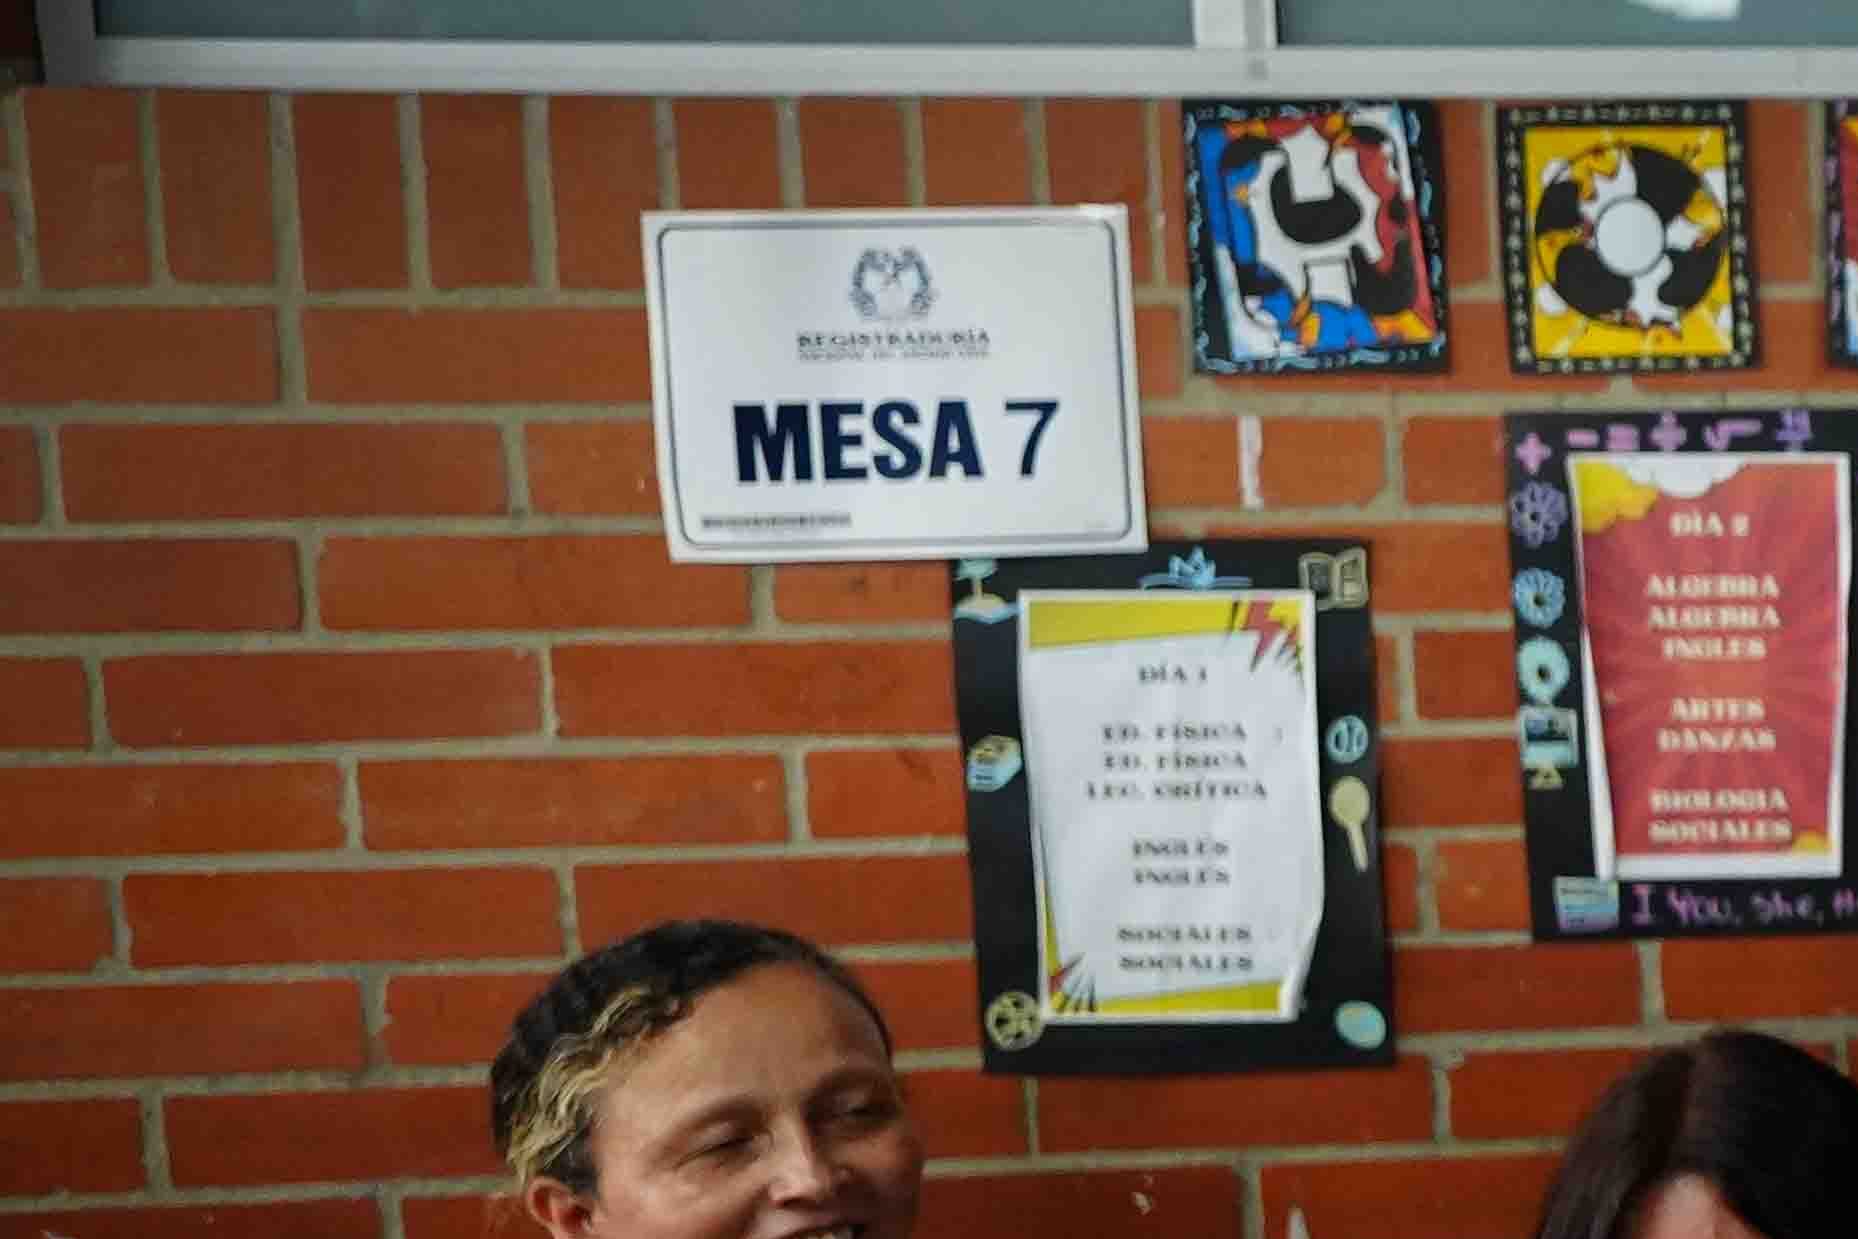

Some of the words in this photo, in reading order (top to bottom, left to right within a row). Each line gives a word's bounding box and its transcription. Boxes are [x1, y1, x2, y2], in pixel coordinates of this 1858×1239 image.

[733, 399, 984, 484] MESA
[1004, 401, 1060, 478] 7
[1671, 697, 1766, 721] ARTES
[1657, 727, 1777, 752] DANZAS
[1648, 817, 1793, 844] SOCIALES
[1118, 926, 1251, 943] SOCIALES
[1120, 955, 1254, 973] SOCIALES
